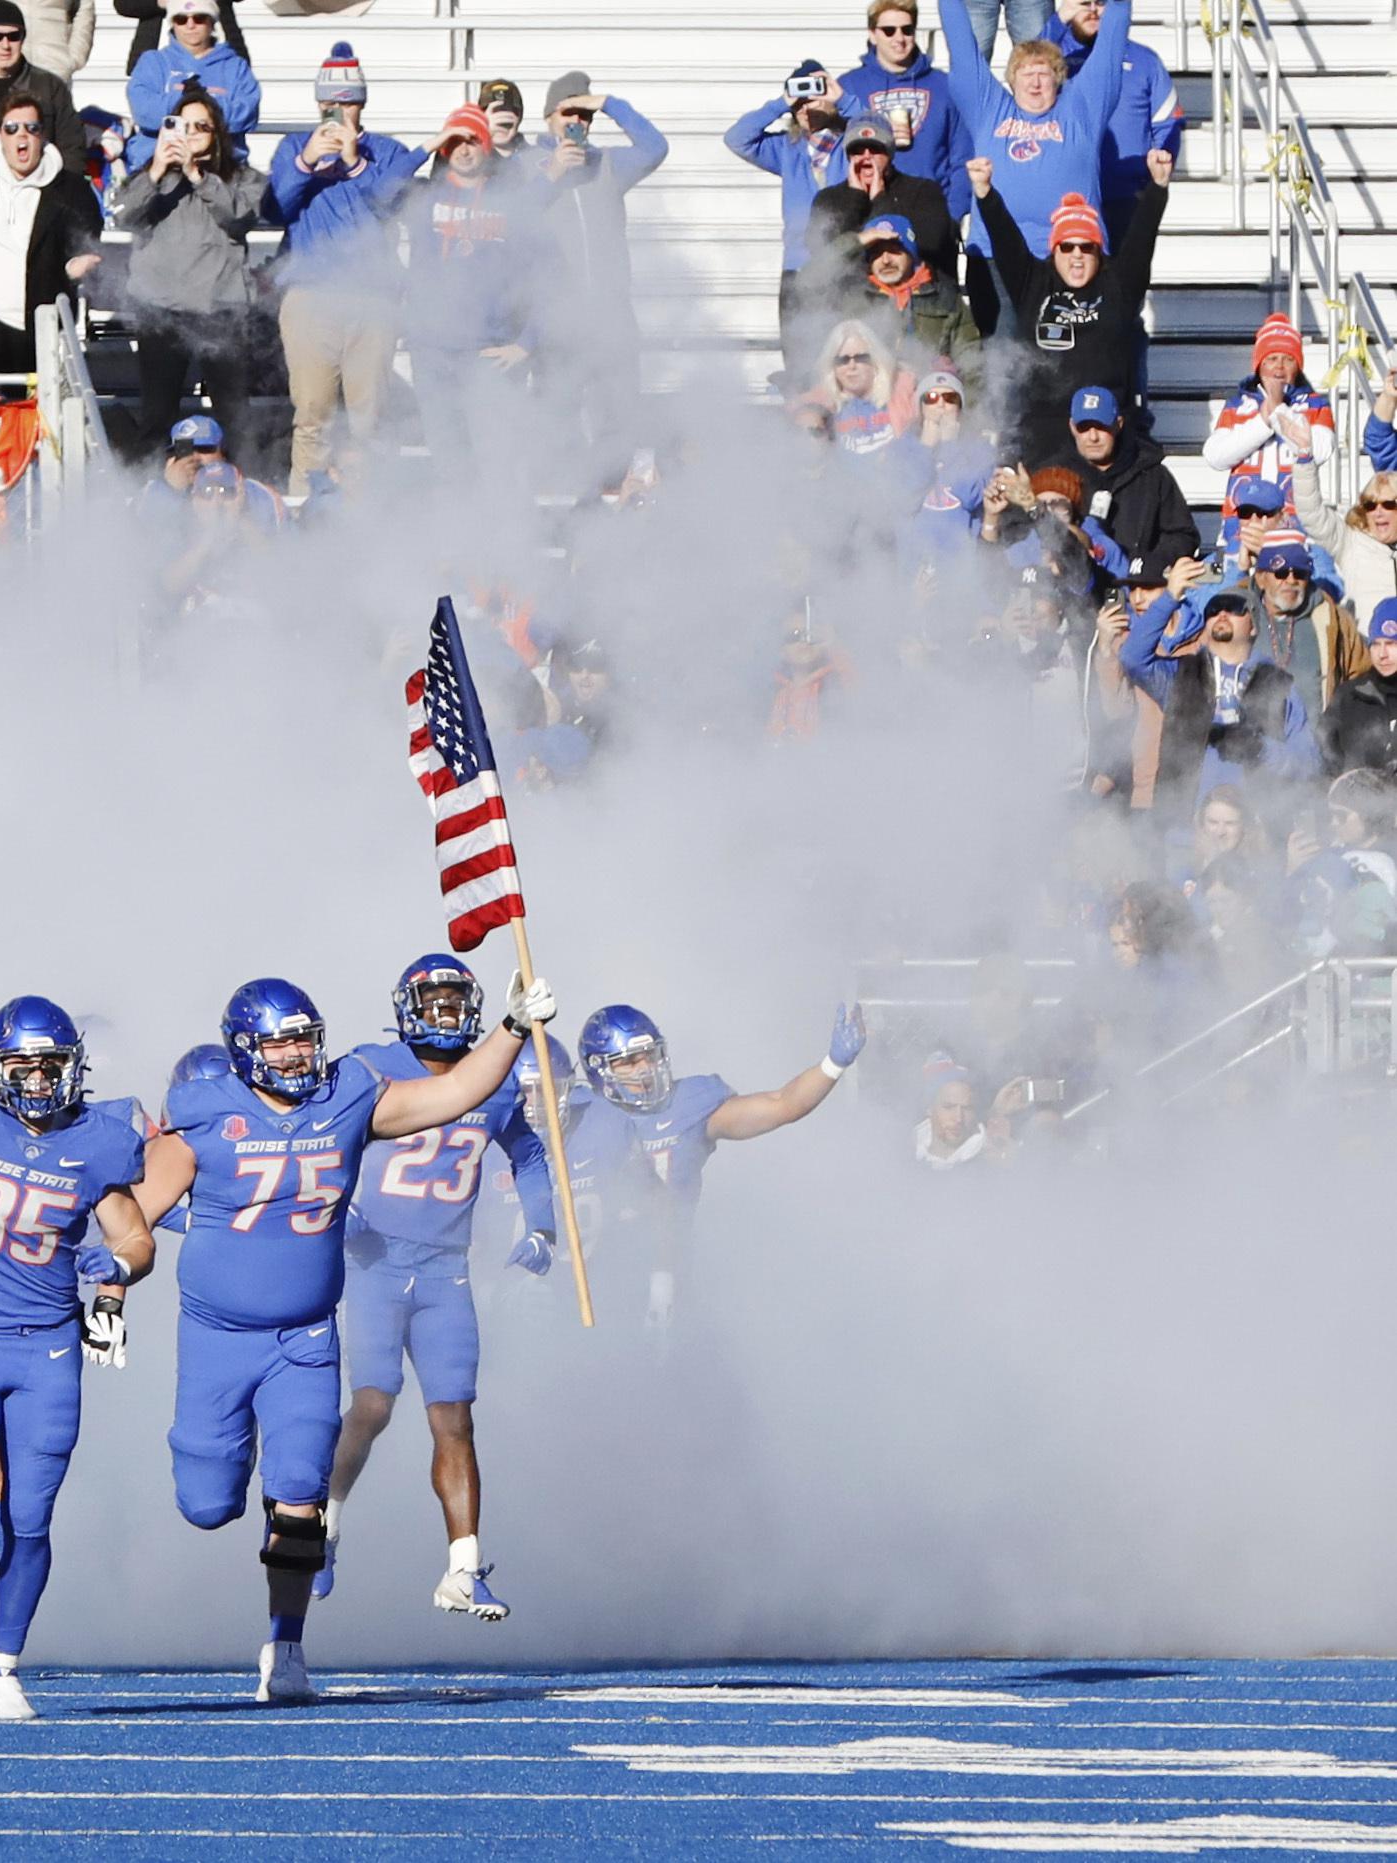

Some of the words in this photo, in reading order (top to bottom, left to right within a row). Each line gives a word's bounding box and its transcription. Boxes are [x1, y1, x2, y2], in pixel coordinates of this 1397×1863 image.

[456, 1112, 488, 1124] ATE
[234, 1140, 288, 1154] BOISE
[290, 1134, 336, 1152] STATE
[641, 1134, 680, 1151] TATE
[379, 1126, 489, 1204] 23
[25, 1168, 78, 1191] STATE
[229, 1149, 345, 1236] 75
